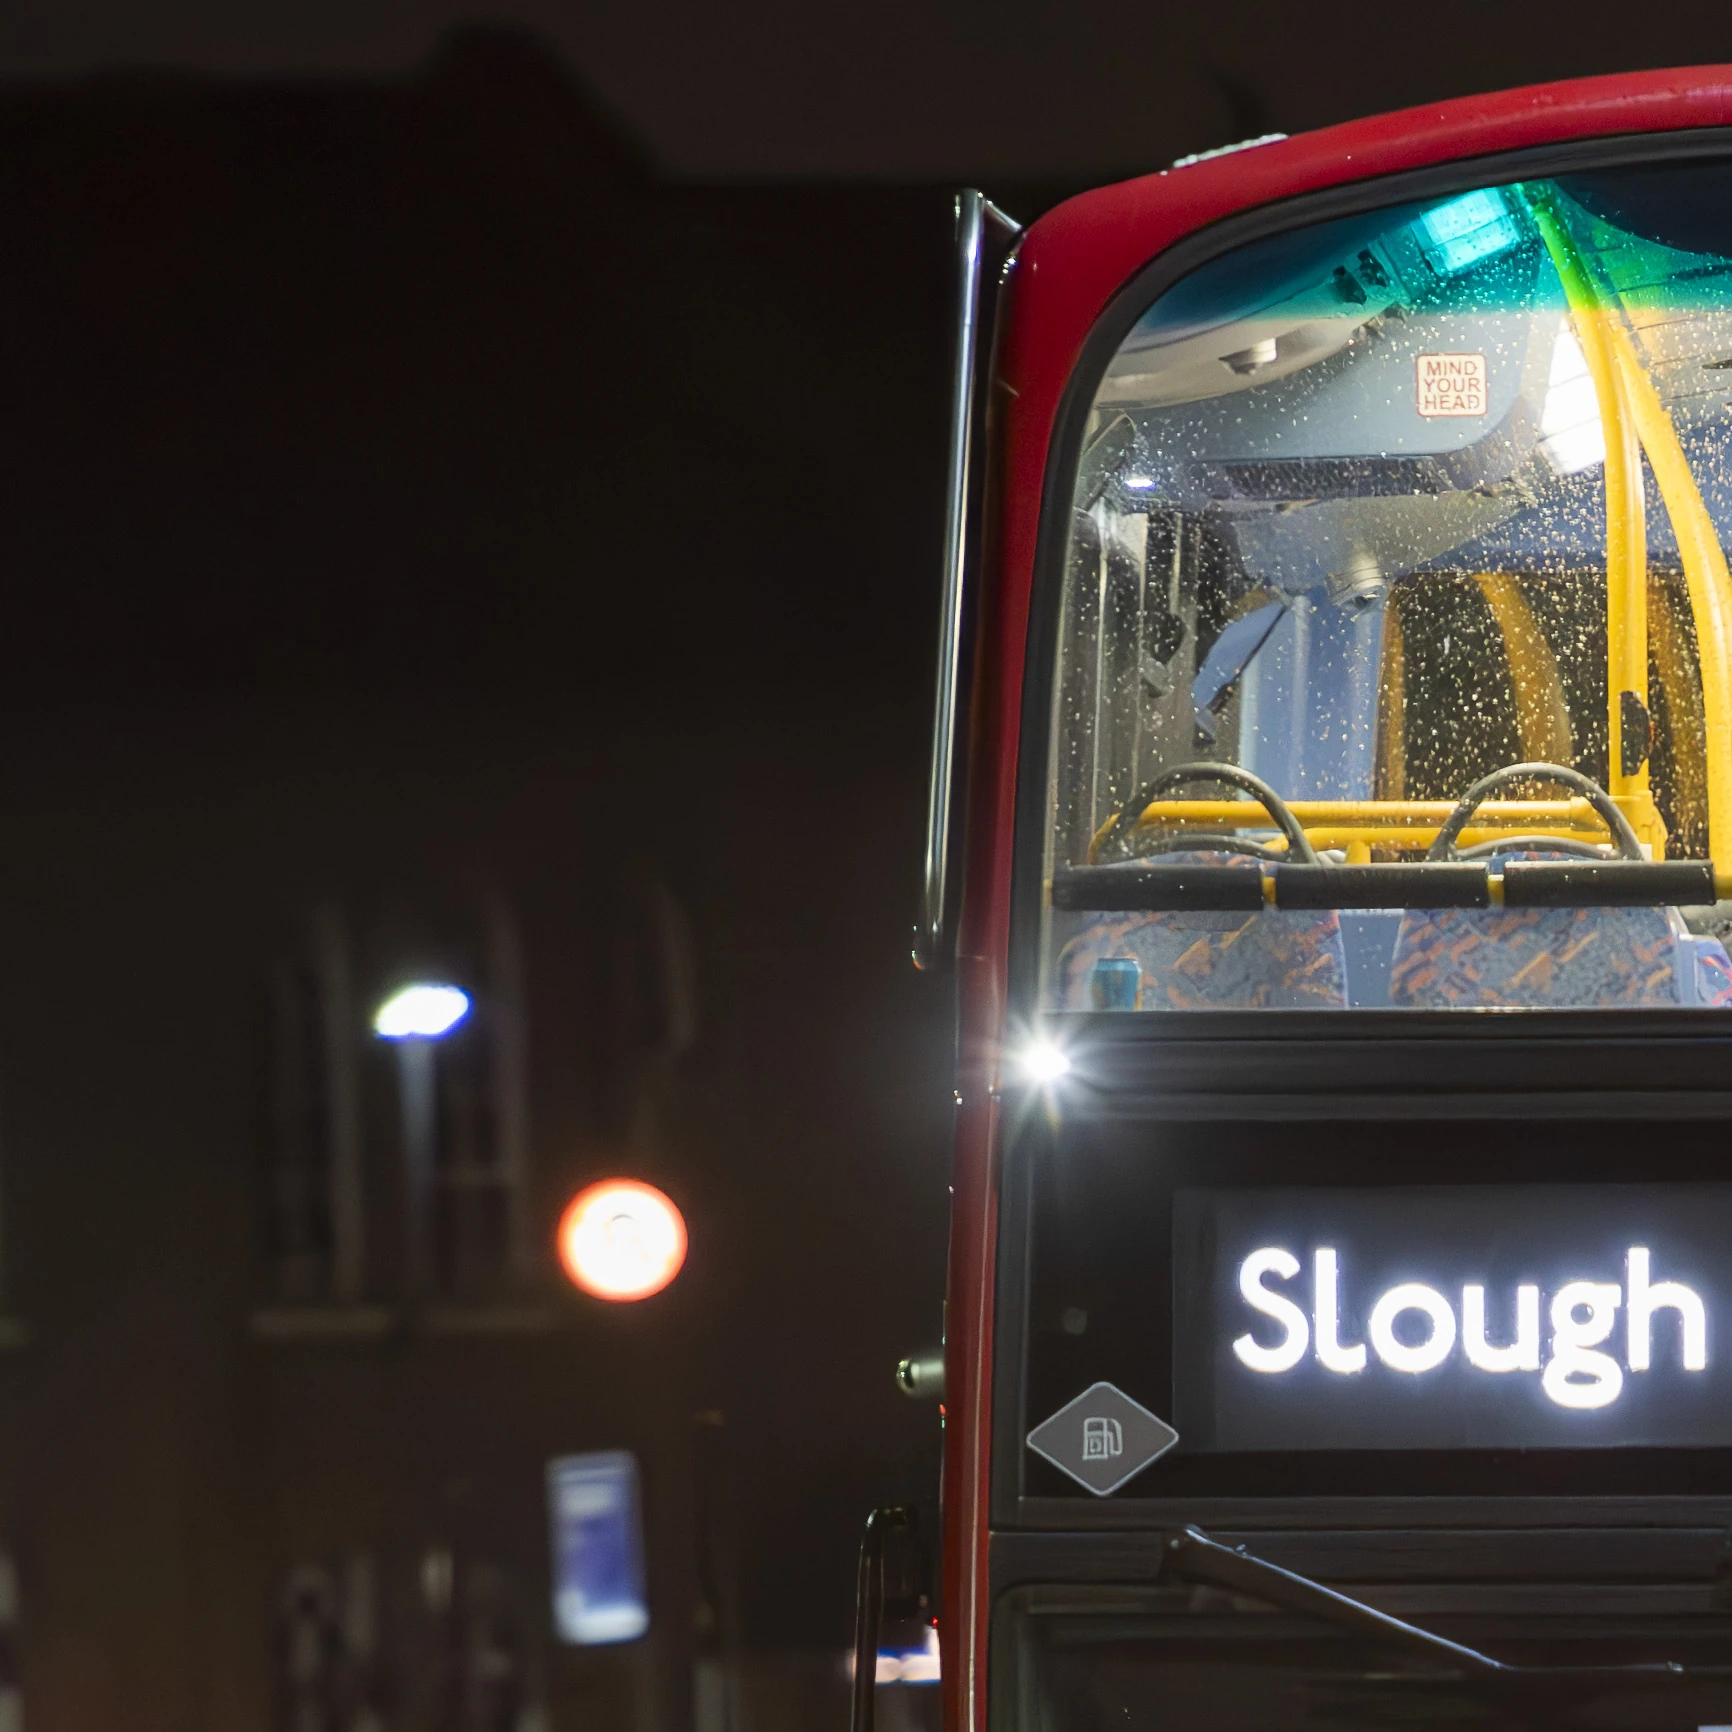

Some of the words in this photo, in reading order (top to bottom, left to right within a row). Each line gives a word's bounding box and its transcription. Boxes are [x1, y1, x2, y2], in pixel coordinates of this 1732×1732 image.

[1426, 361, 1477, 376] MIND
[1424, 378, 1481, 393] YOUR
[1424, 394, 1480, 410] HEAD
[1233, 1246, 1708, 1409] Slough
